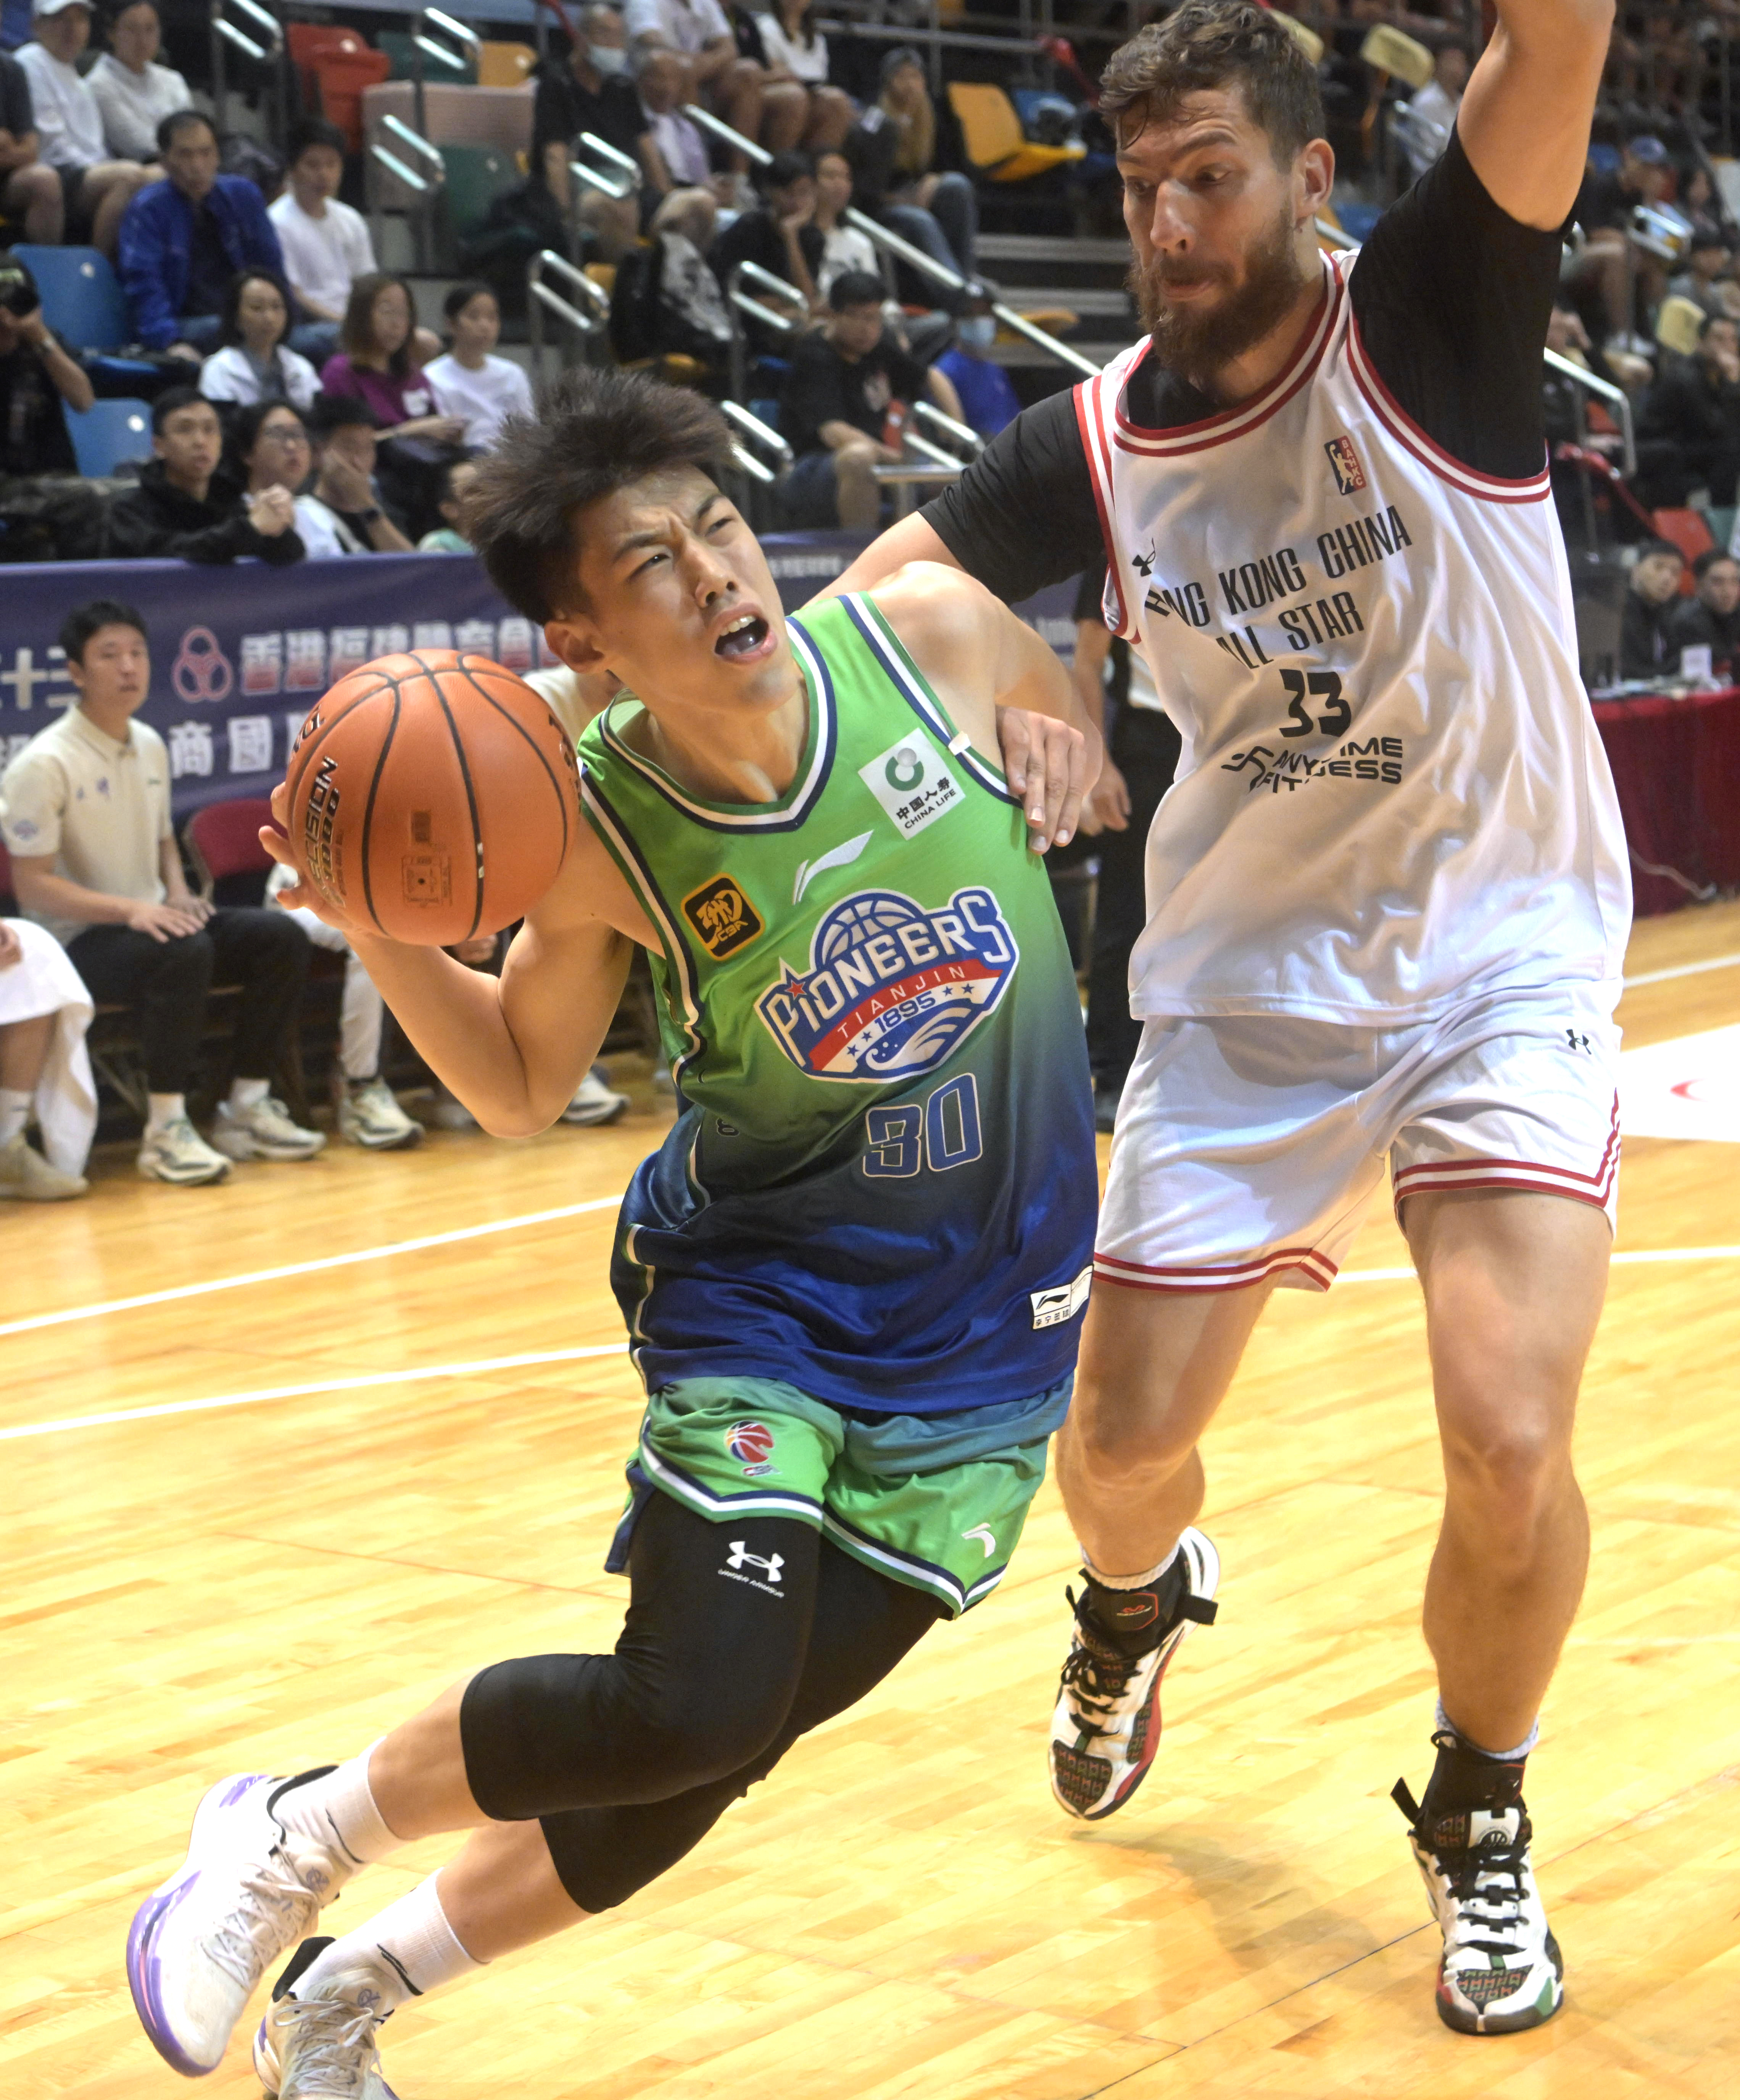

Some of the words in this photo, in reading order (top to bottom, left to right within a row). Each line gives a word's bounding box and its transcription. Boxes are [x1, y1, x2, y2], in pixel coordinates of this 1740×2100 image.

[1219, 548, 1306, 615] KONG
[1316, 506, 1412, 578] CHINA
[1278, 592, 1365, 651] STAR
[1279, 669, 1352, 738] 33
[1273, 737, 1403, 776] ANYIME
[896, 776, 950, 820] 中国人寿
[904, 806, 935, 829] CHINA
[936, 788, 956, 807] LIFE
[837, 965, 966, 1039] TIANJIN
[874, 990, 936, 1033] 1895
[862, 1072, 983, 1178] 30
